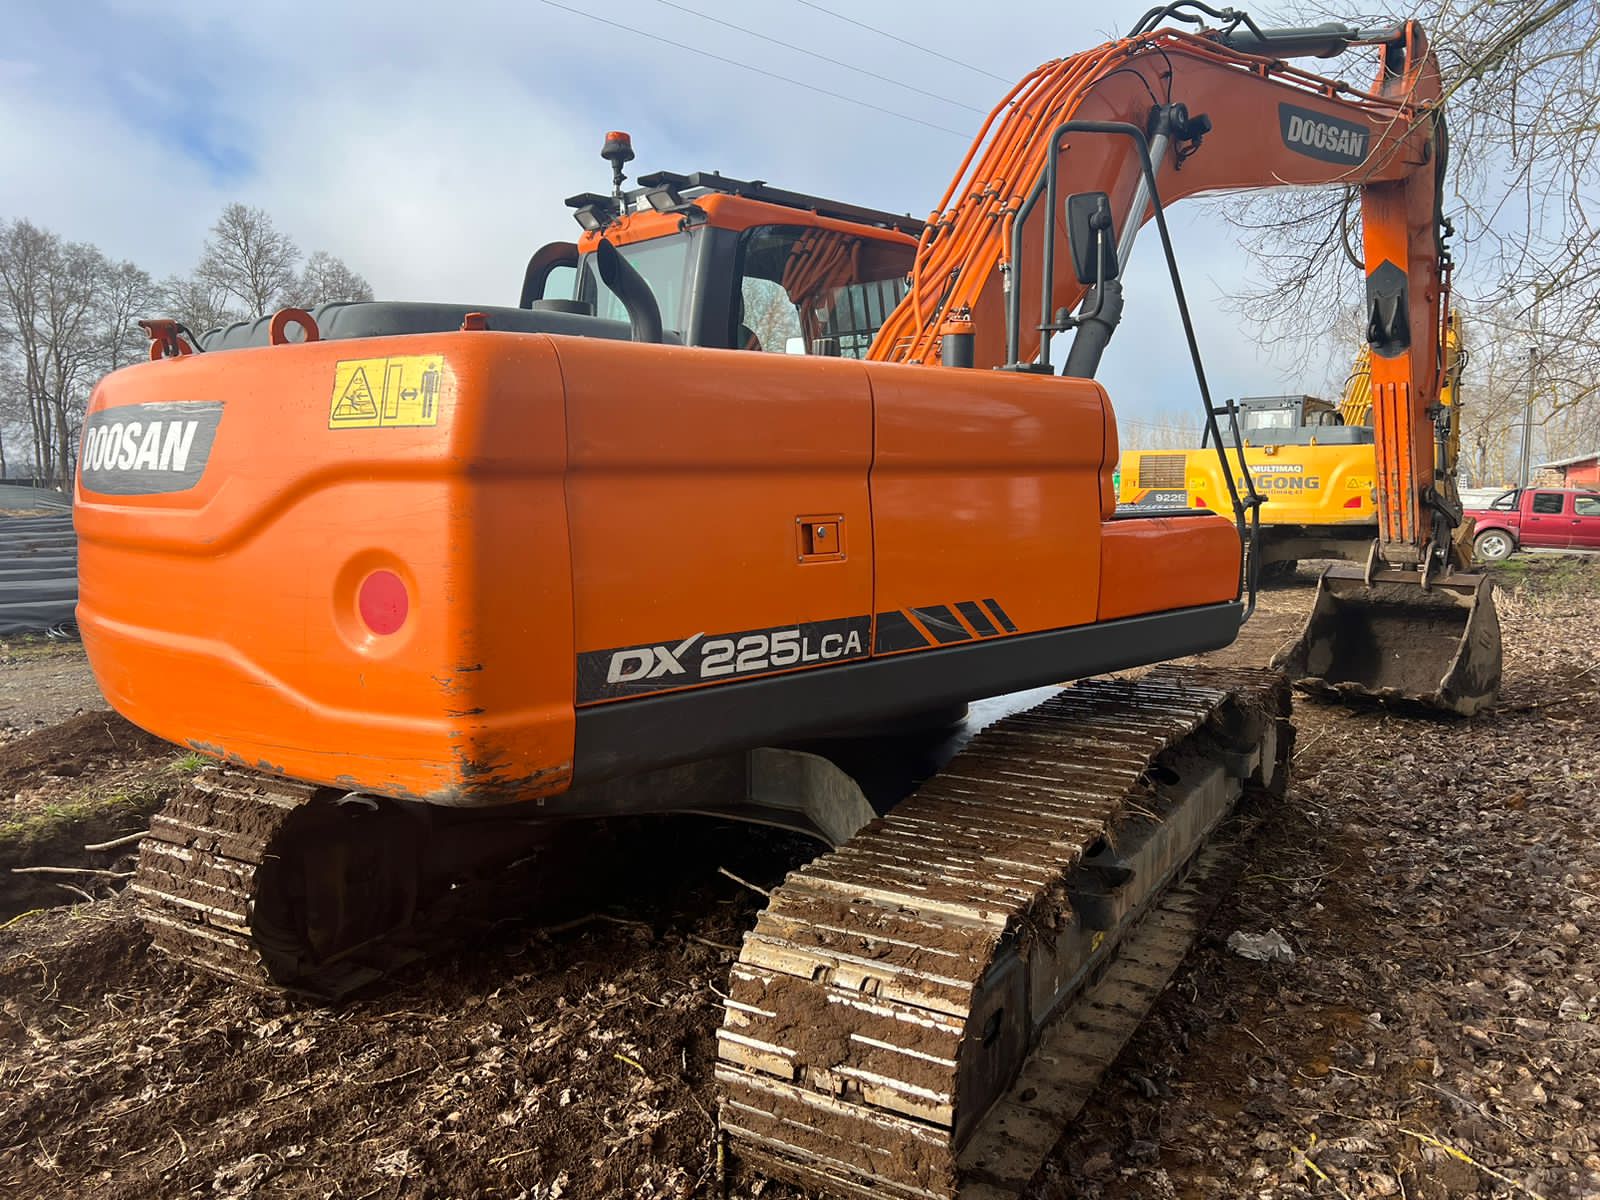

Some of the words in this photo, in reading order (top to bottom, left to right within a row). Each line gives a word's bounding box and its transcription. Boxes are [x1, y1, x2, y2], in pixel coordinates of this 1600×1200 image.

[1287, 115, 1363, 157] DOOSAN
[82, 421, 199, 472] DOOSAN
[607, 632, 705, 684] DX
